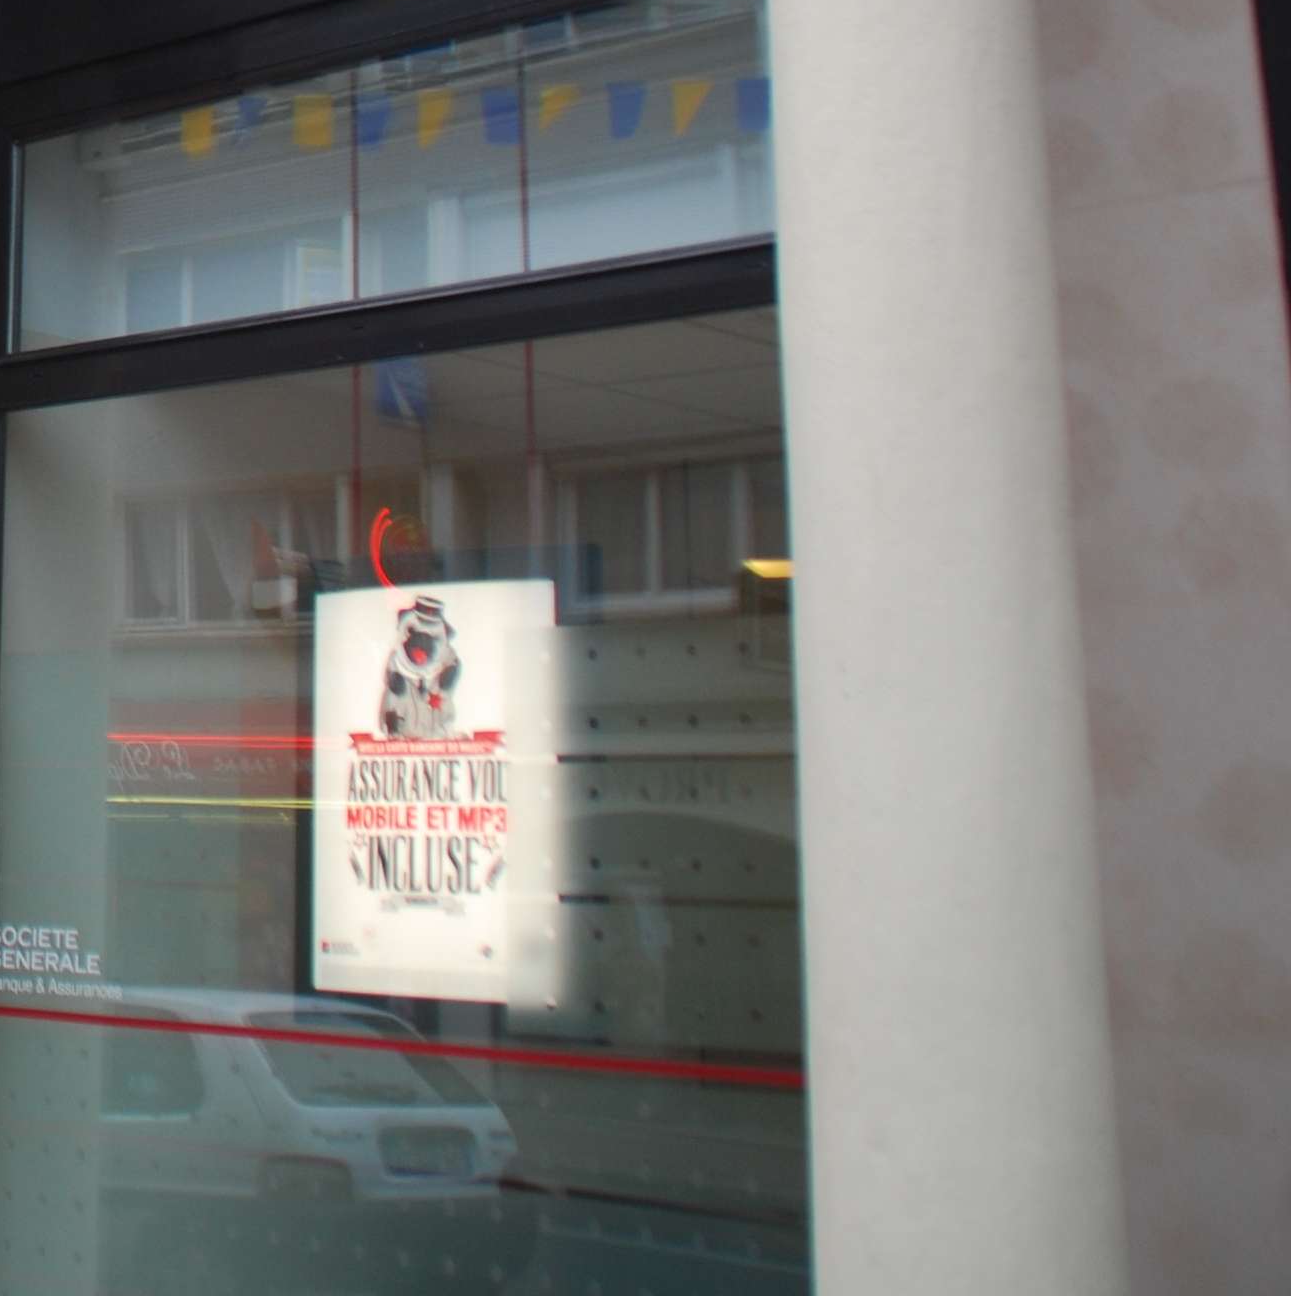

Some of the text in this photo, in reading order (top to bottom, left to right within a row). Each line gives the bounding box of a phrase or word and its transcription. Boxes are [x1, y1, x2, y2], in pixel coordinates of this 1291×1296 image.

[347, 759, 460, 802] ASSURANCE
[347, 806, 507, 832] MOBILE ET MP3
[368, 835, 482, 894] INCLUSE
[35, 977, 45, 994] &
[48, 977, 123, 1000] Assurances
